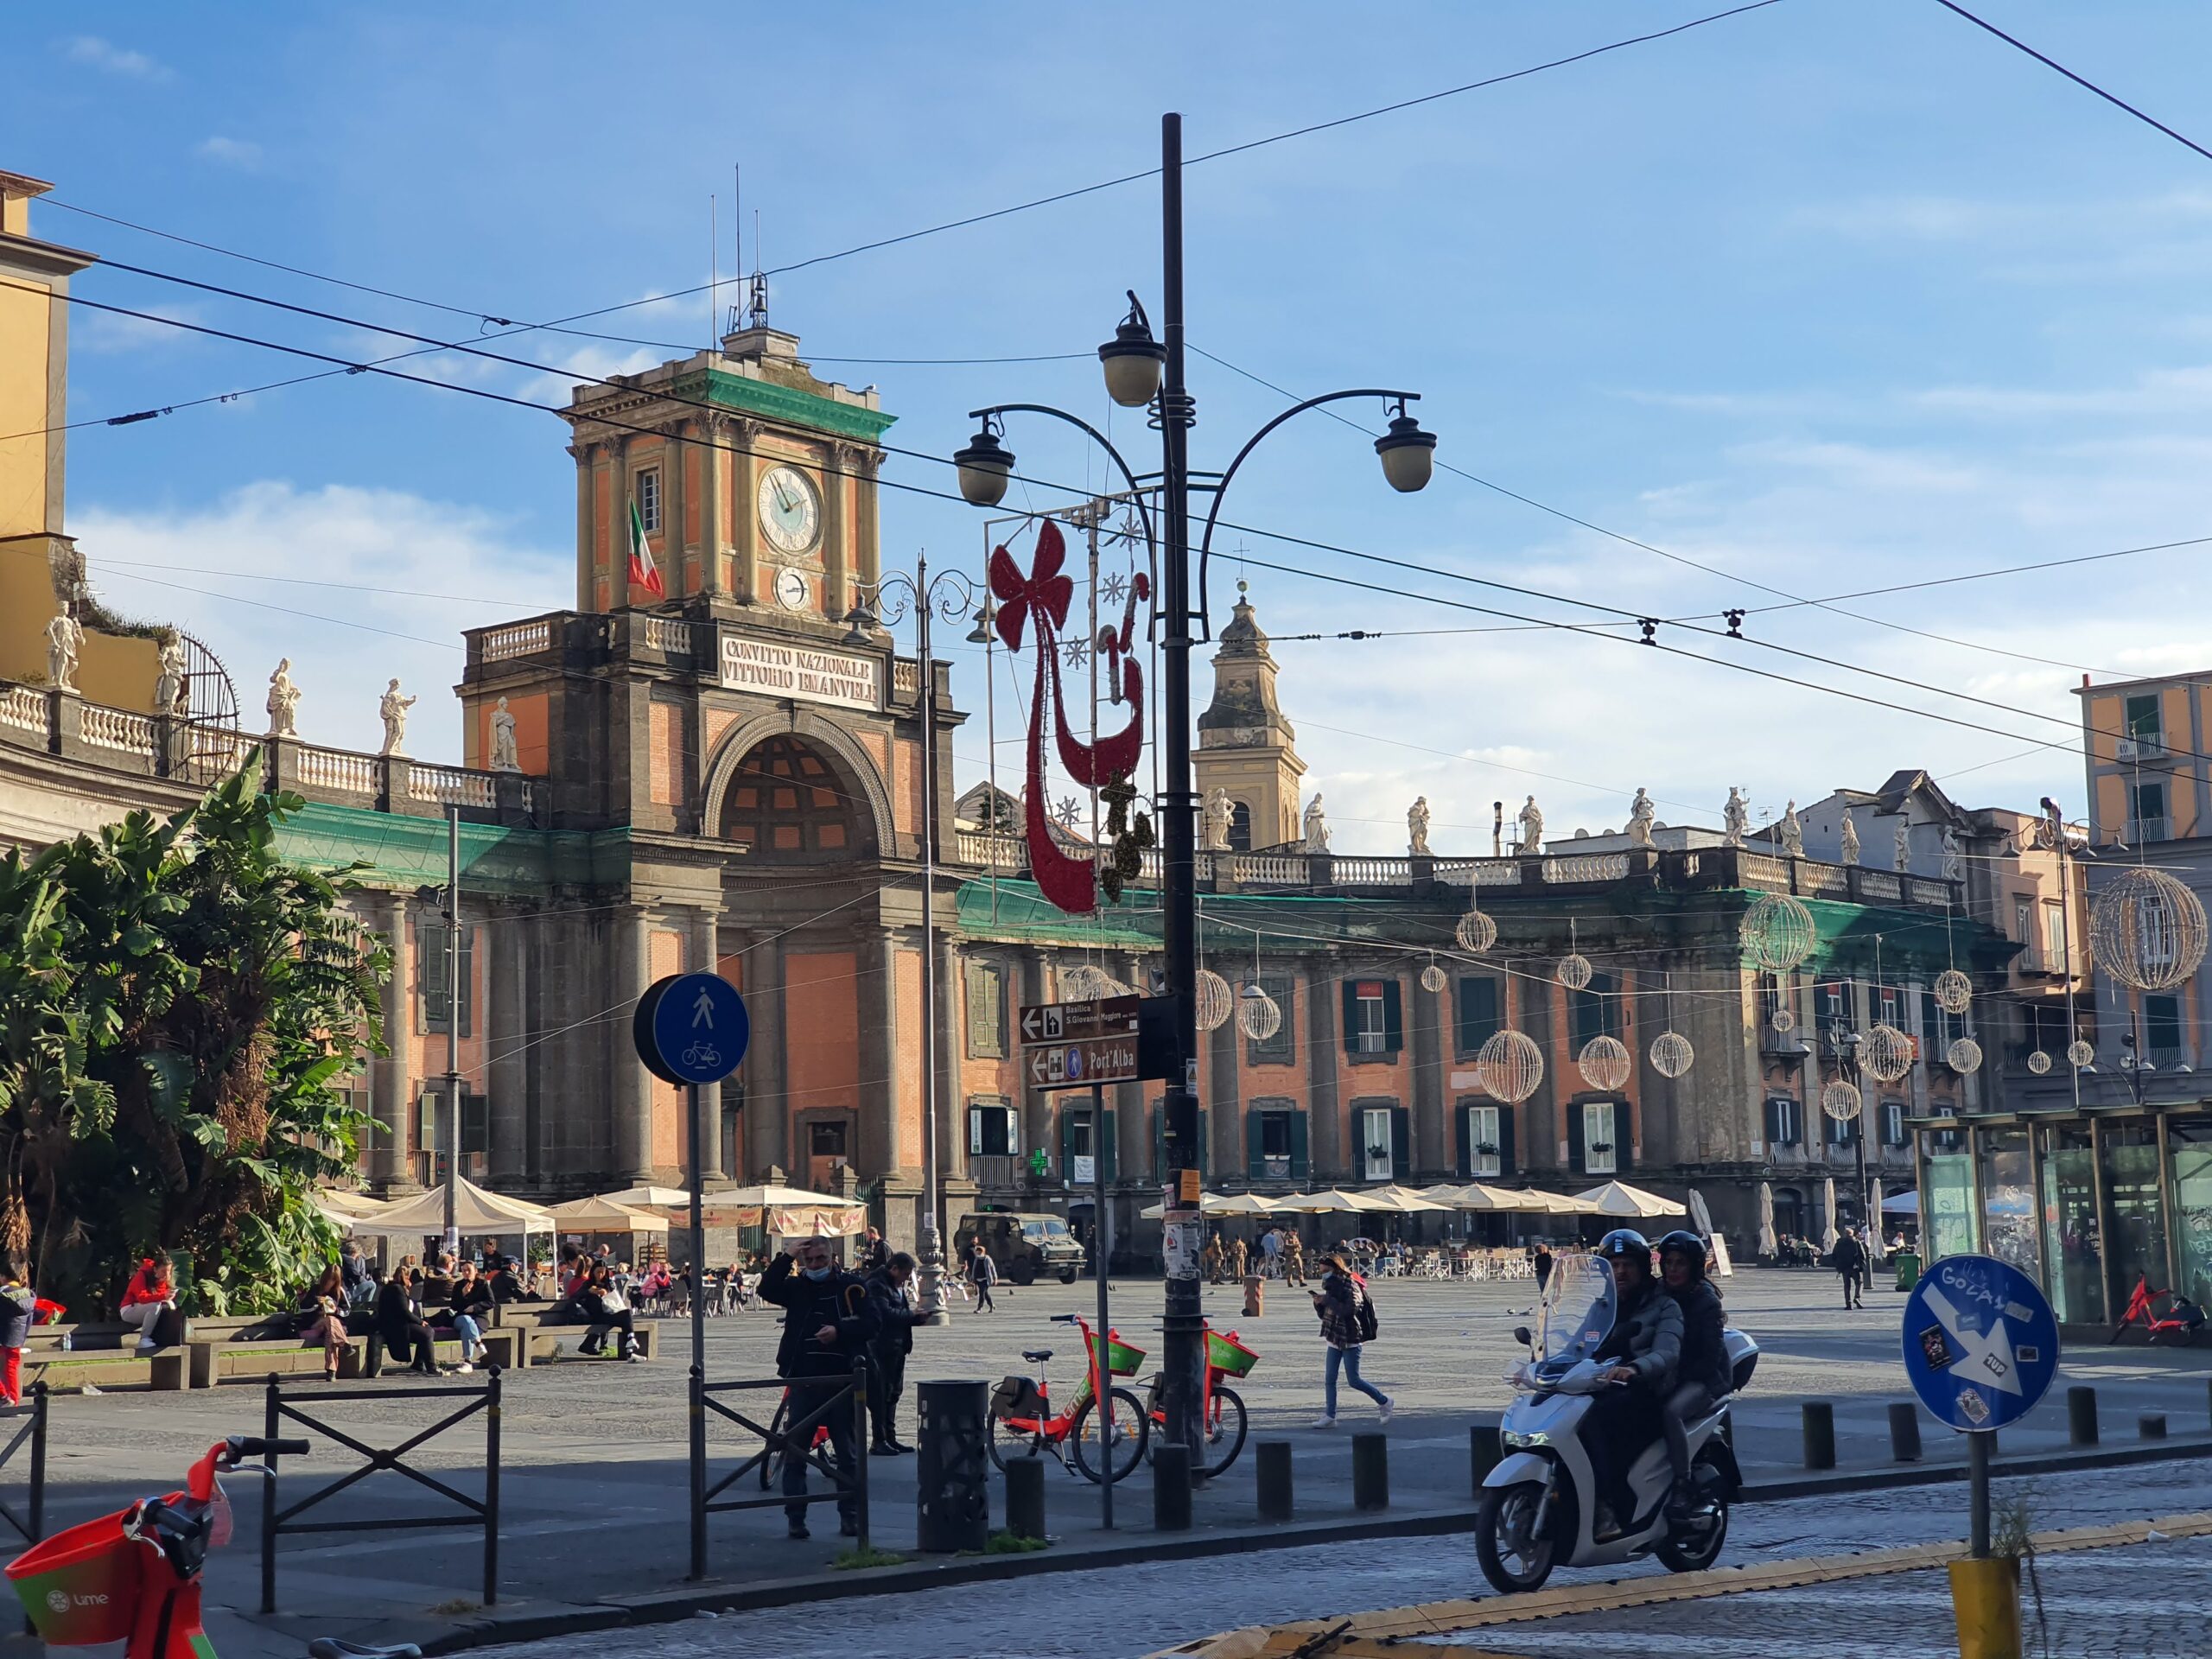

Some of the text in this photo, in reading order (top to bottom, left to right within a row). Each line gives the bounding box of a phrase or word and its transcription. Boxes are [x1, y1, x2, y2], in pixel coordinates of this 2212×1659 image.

[726, 640, 869, 679] CONVITTO NAZIONALE
[722, 660, 794, 689] VITTORIO
[1065, 1004, 1091, 1014] Basilica
[1100, 1011, 1122, 1022] Maggiore
[1090, 1047, 1135, 1071] Port'Alba
[1986, 1354, 2006, 1373] 1UP
[1063, 1381, 1089, 1421] Lime
[73, 1593, 108, 1605] Lime
